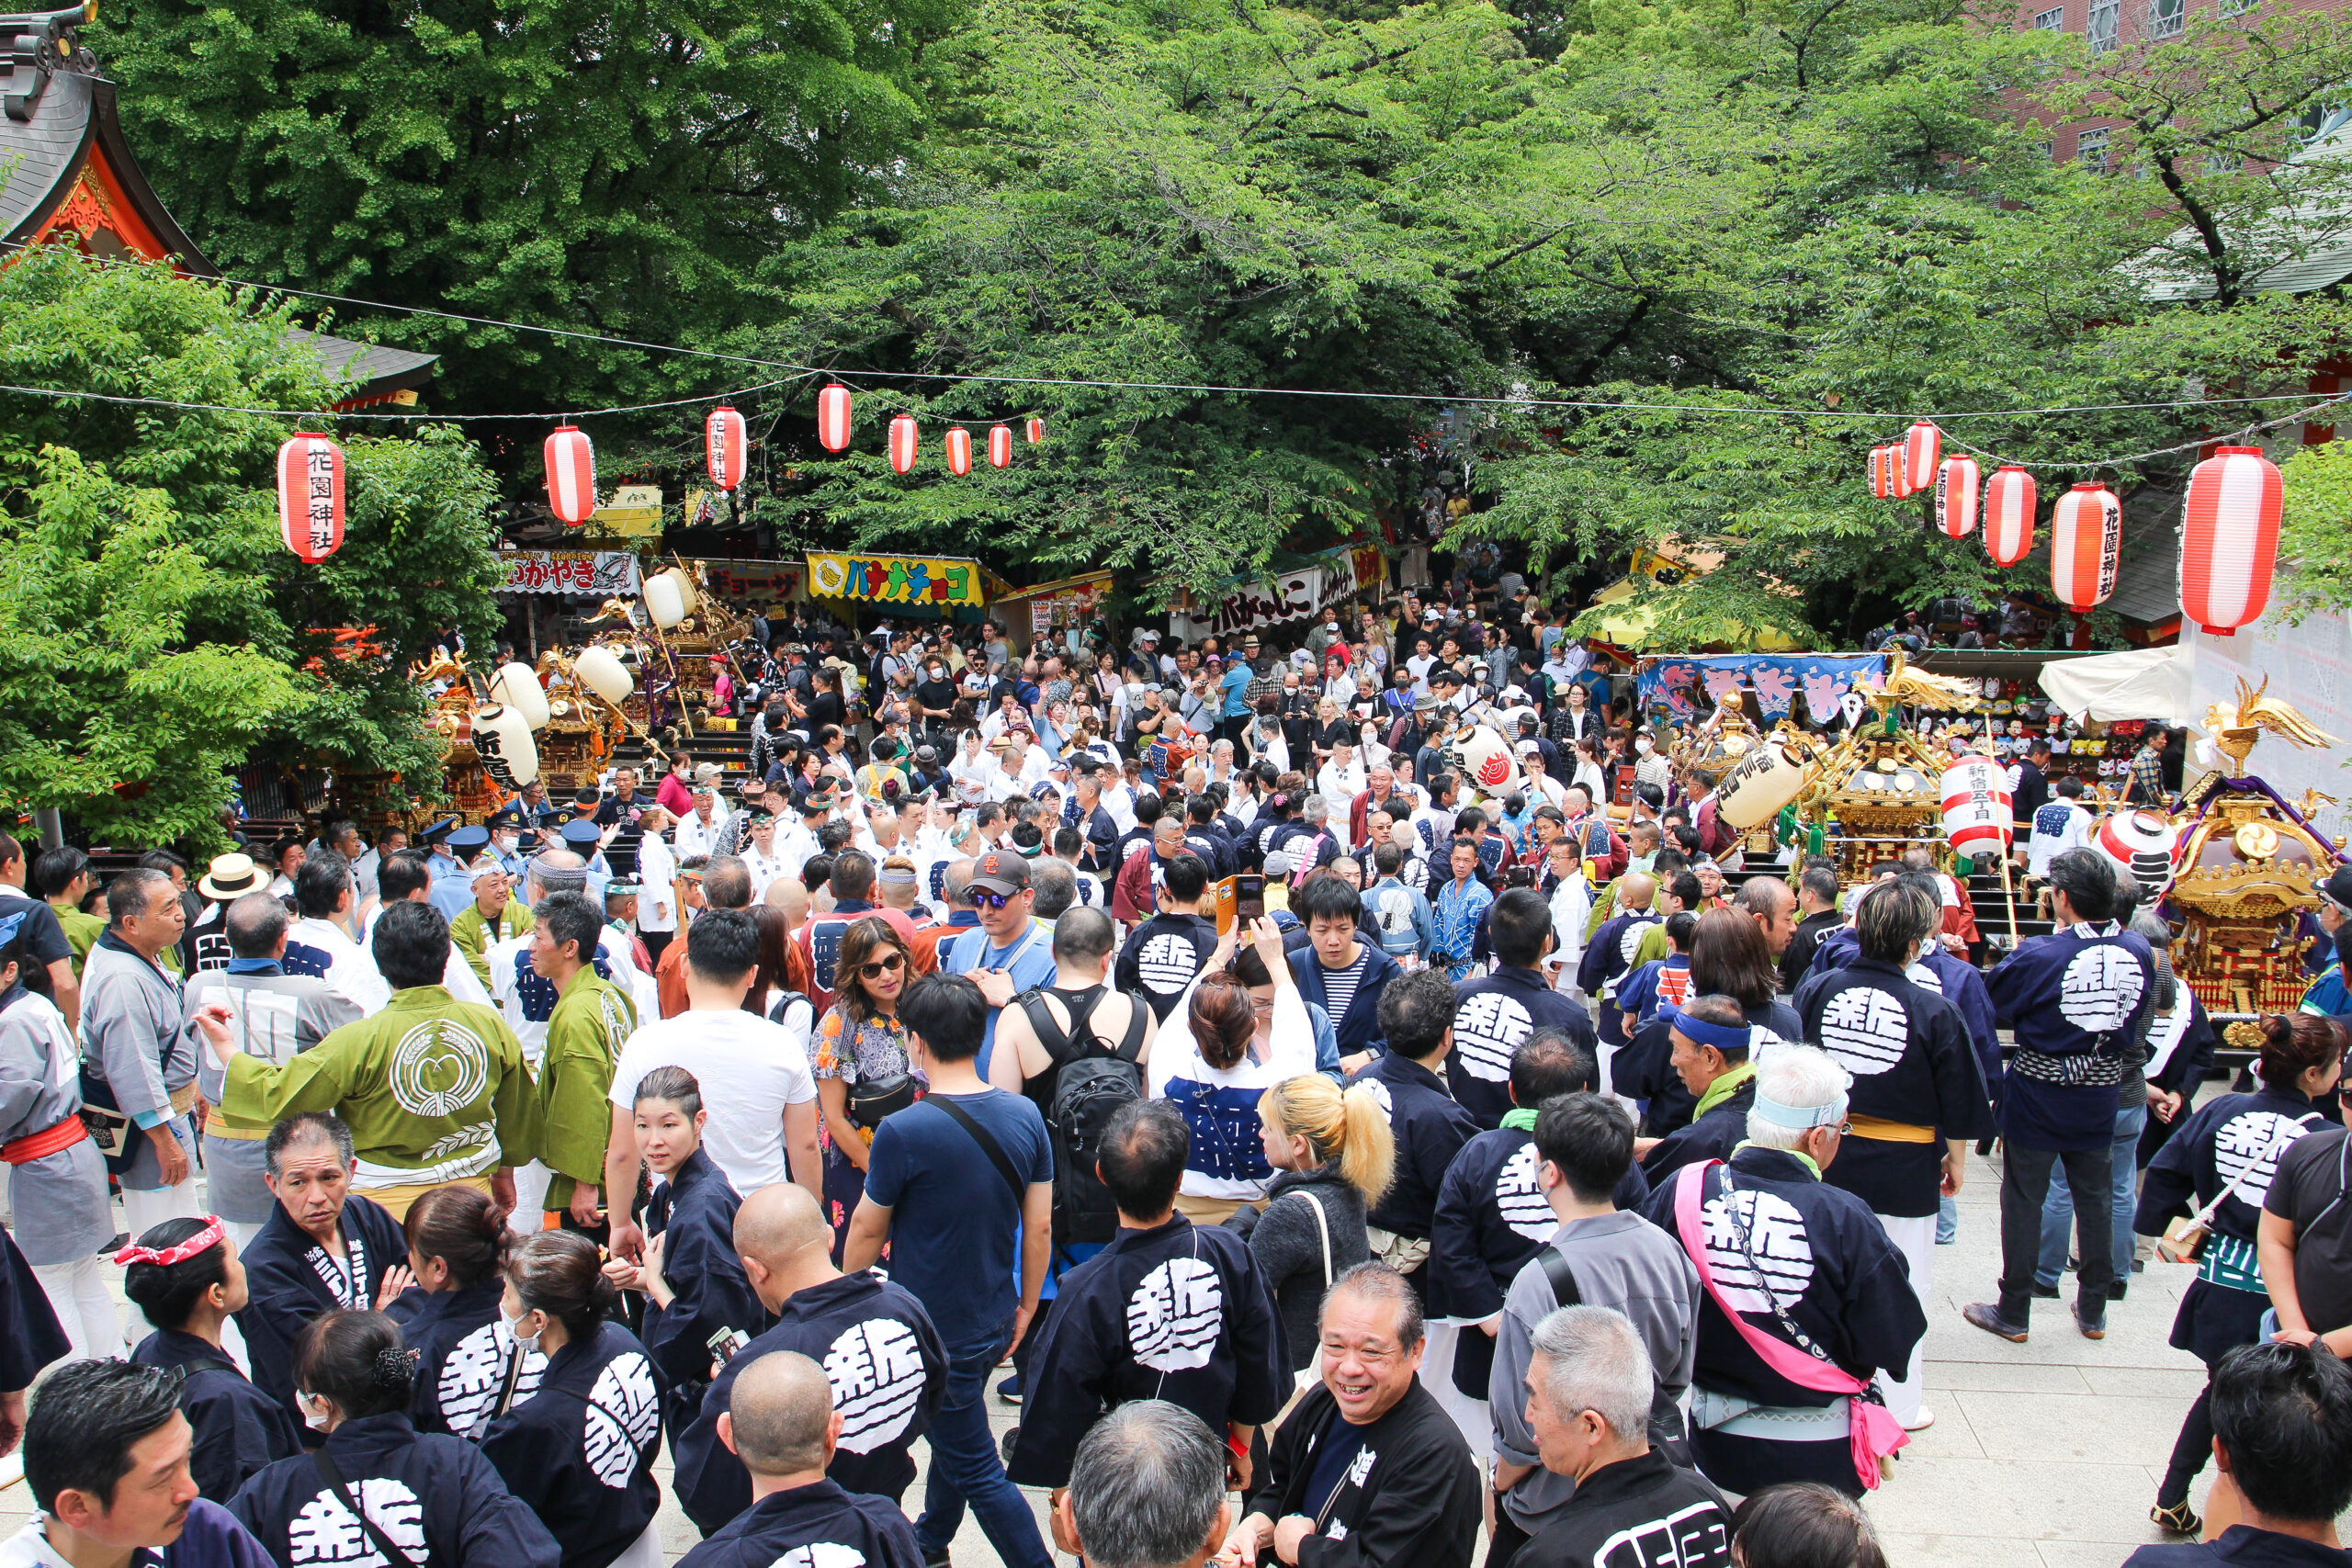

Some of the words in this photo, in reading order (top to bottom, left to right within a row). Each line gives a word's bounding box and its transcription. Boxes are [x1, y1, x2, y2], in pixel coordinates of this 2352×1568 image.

[710, 416, 727, 481] 花園神社
[306, 449, 334, 552] 花園神社
[2100, 507, 2120, 599] 花園神社
[707, 568, 800, 600] ギョーザ
[843, 559, 970, 601] バナナチョコ
[1751, 666, 1796, 702] 氷
[1802, 672, 1849, 722] 氷
[1968, 764, 1990, 821] 新宿五丁目
[983, 855, 1000, 875] BC
